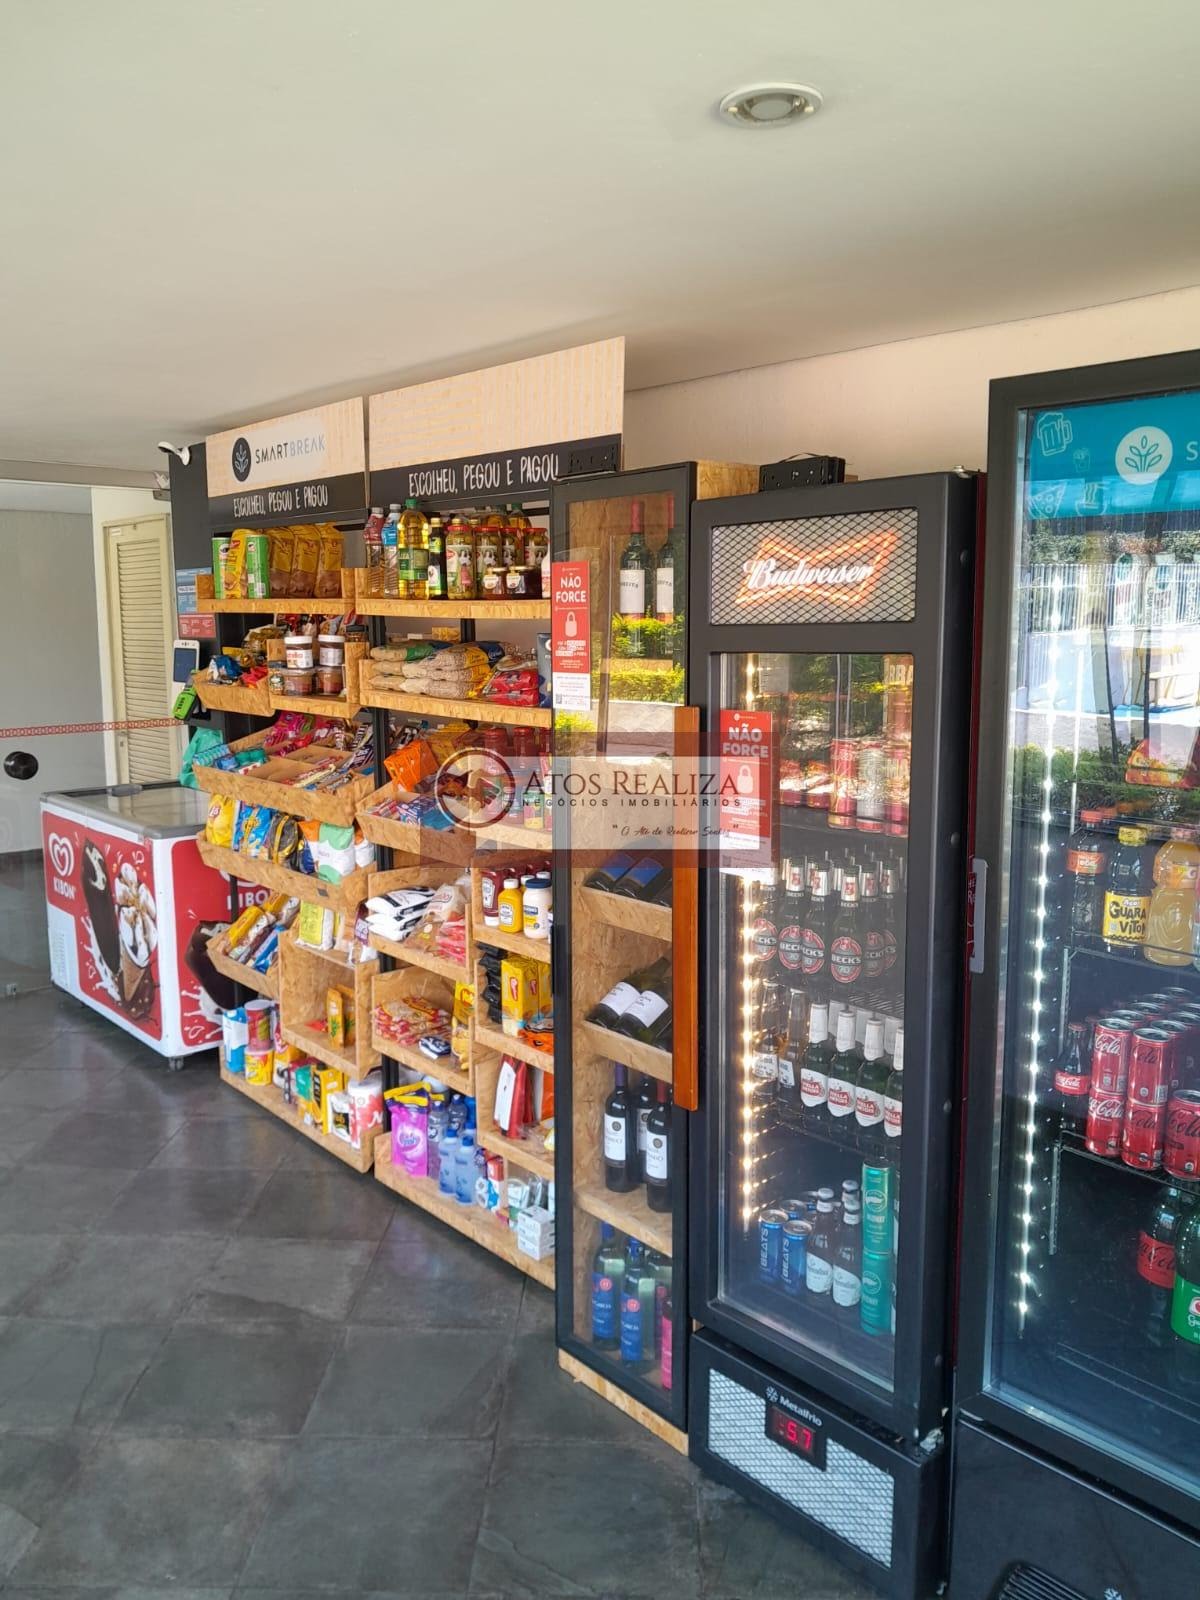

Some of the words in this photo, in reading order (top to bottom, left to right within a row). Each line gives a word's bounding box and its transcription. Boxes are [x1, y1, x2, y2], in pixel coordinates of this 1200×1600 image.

[408, 467, 458, 497] ESCOLHEU,
[463, 461, 500, 491] PEGOU
[506, 459, 513, 486] E
[520, 453, 559, 484] PAGOU
[233, 494, 266, 518] ESCOLHEU,
[268, 486, 293, 514] PEGOU
[295, 489, 301, 509] E
[303, 483, 328, 508] PAGOU
[560, 573, 582, 588] NÃO
[743, 558, 874, 590] Budweiser
[555, 590, 587, 603] FORCE
[728, 723, 762, 743] NÃO
[722, 742, 769, 759] FORCE
[780, 1395, 823, 1427] Metalfrio
